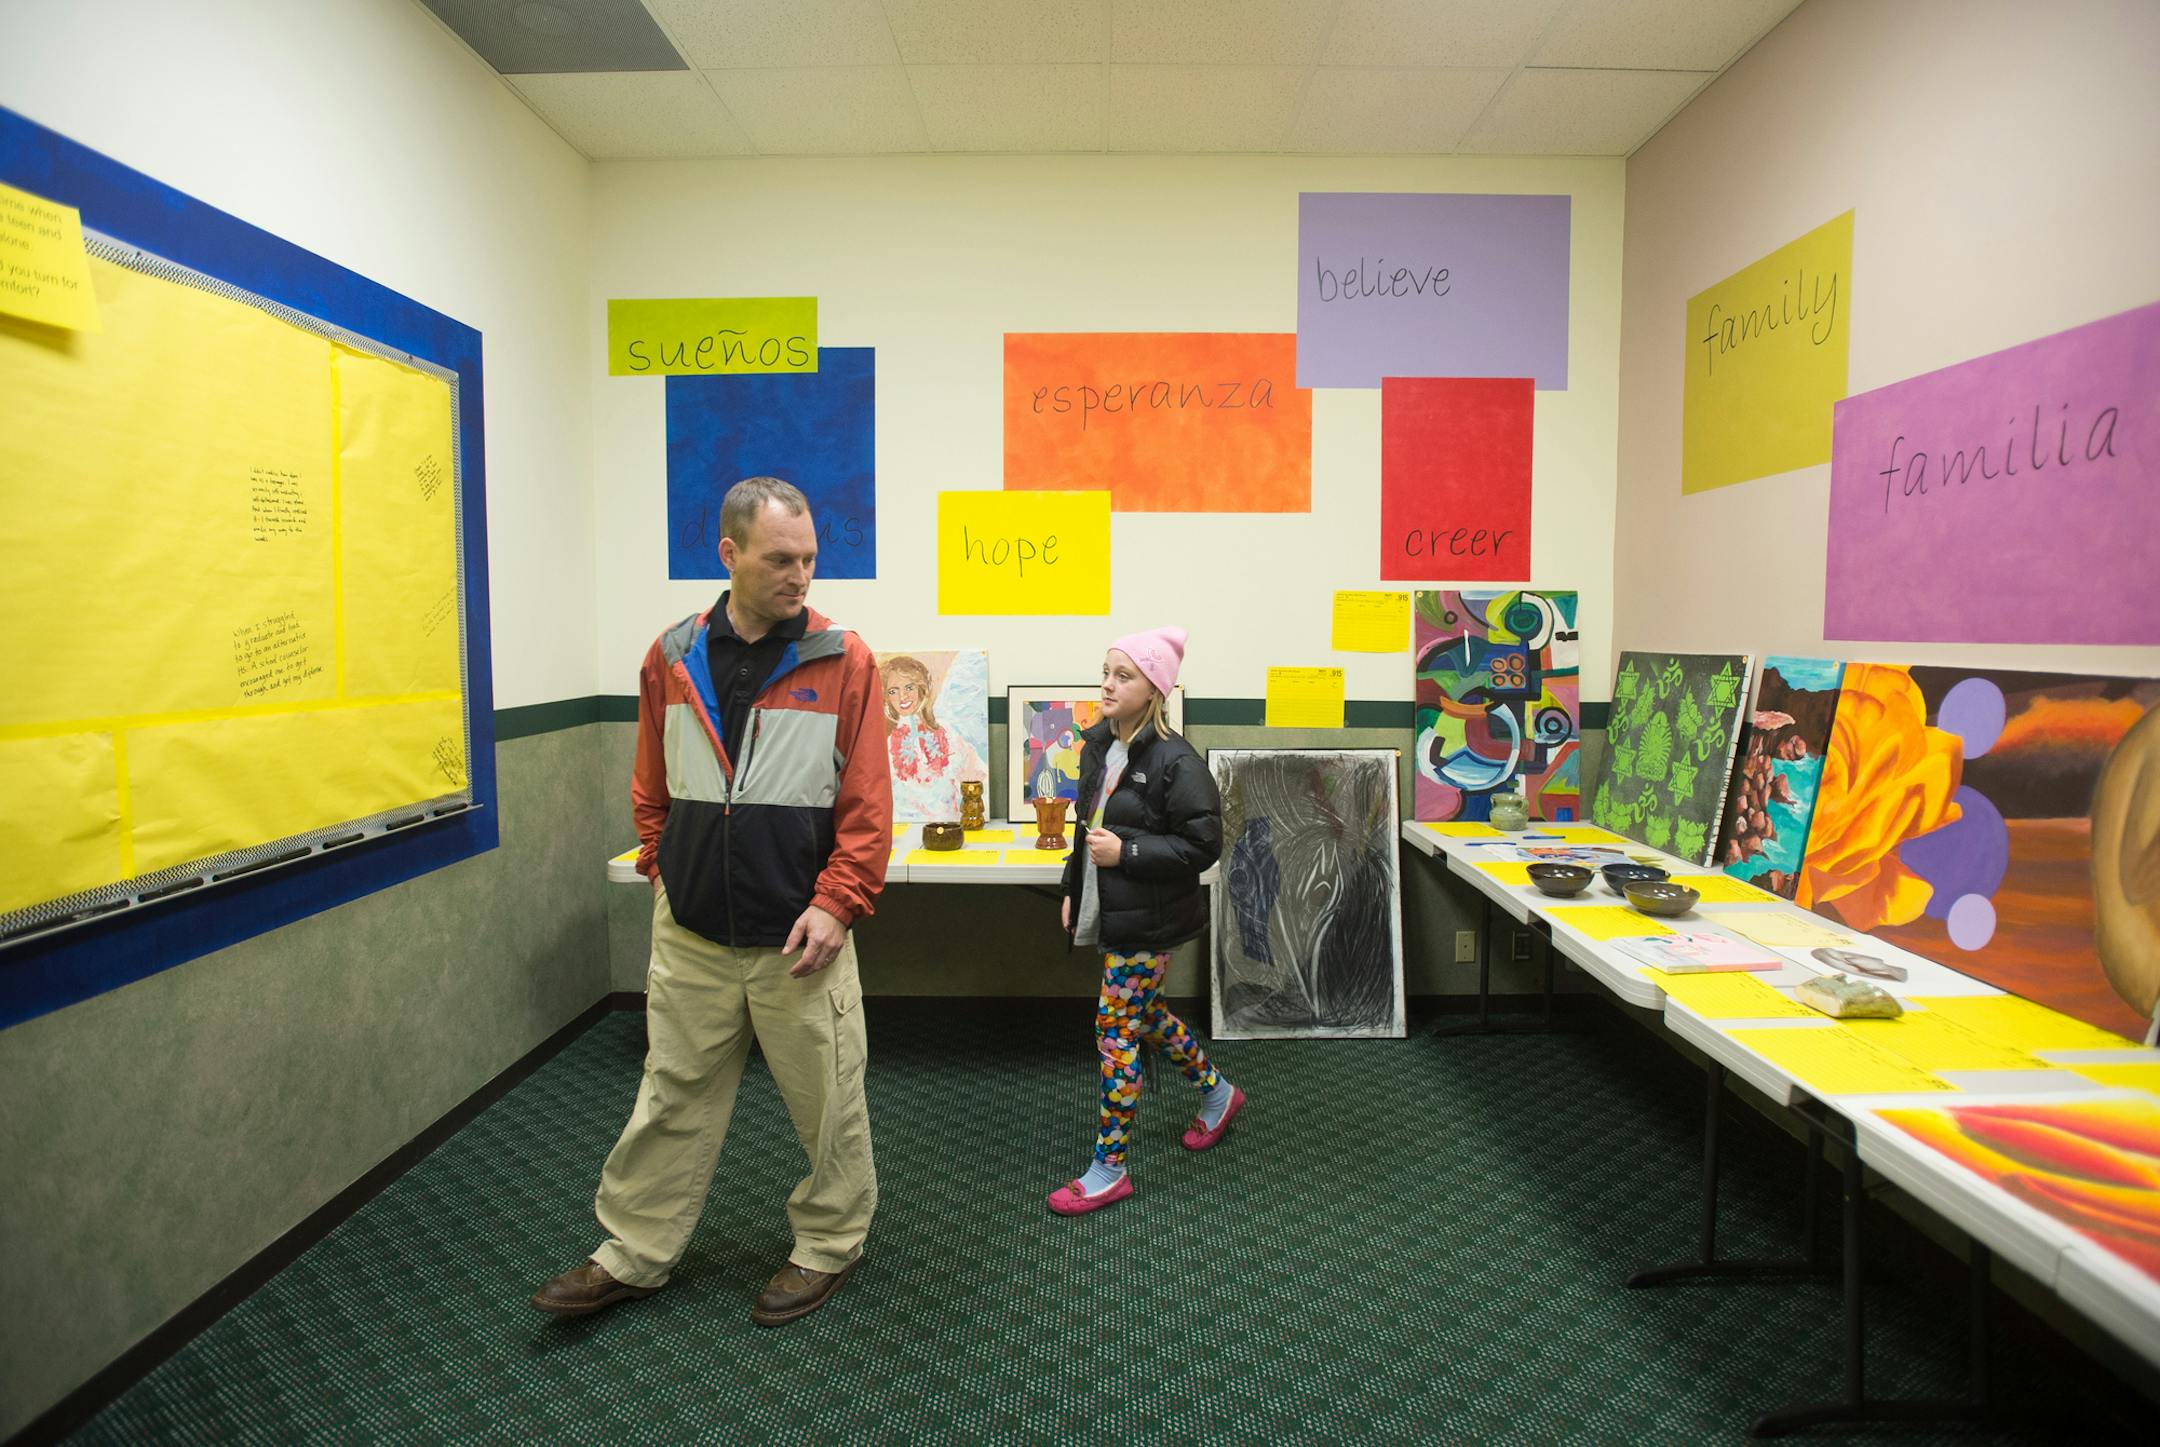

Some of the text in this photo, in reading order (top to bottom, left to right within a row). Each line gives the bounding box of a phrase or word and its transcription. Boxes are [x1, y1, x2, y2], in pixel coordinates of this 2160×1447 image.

[8, 214, 35, 233] teen
[38, 227, 63, 241] and
[29, 207, 63, 224] when
[0, 279, 40, 298] mfort?
[8, 262, 30, 279] you
[34, 270, 59, 287] turn
[62, 275, 78, 290] for
[1317, 255, 1451, 302] believe
[1703, 269, 1837, 376] family
[628, 330, 810, 371] sueños
[1033, 378, 1274, 431] esperanza
[1879, 403, 2120, 513] familia
[964, 525, 1058, 578] hope
[1405, 527, 1513, 557] creer
[1398, 594, 1409, 602] 915
[1331, 670, 1343, 678] 915
